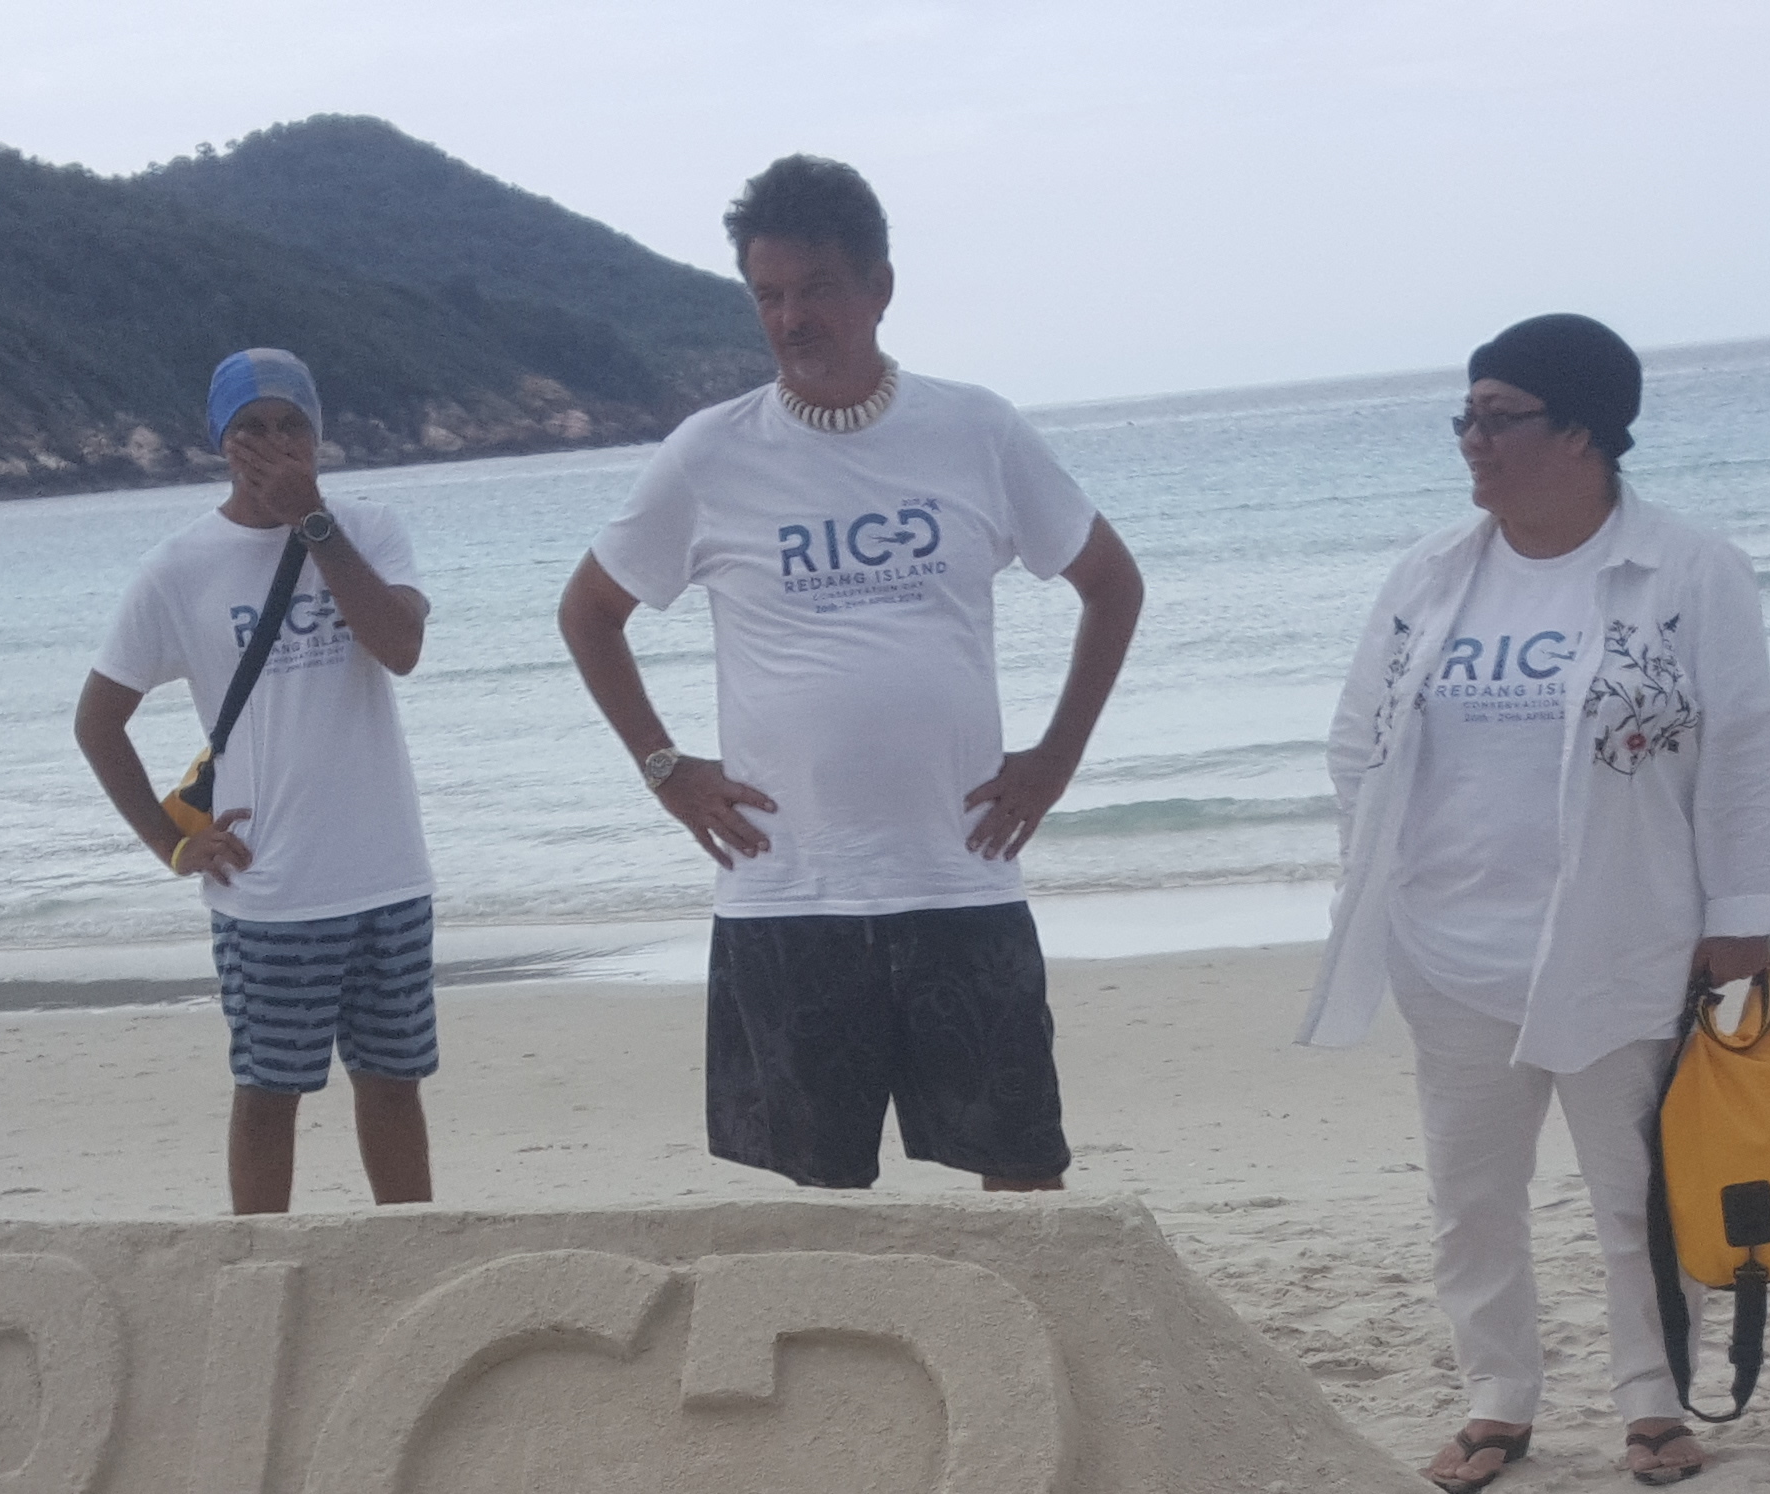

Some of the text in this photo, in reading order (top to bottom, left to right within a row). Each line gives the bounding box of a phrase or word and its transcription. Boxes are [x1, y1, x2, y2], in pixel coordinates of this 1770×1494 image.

[784, 541, 948, 594] REDANG ISLAND
[230, 590, 347, 648] RC
[1441, 630, 1583, 681] RIC
[1434, 682, 1567, 698] REDANG ISL
